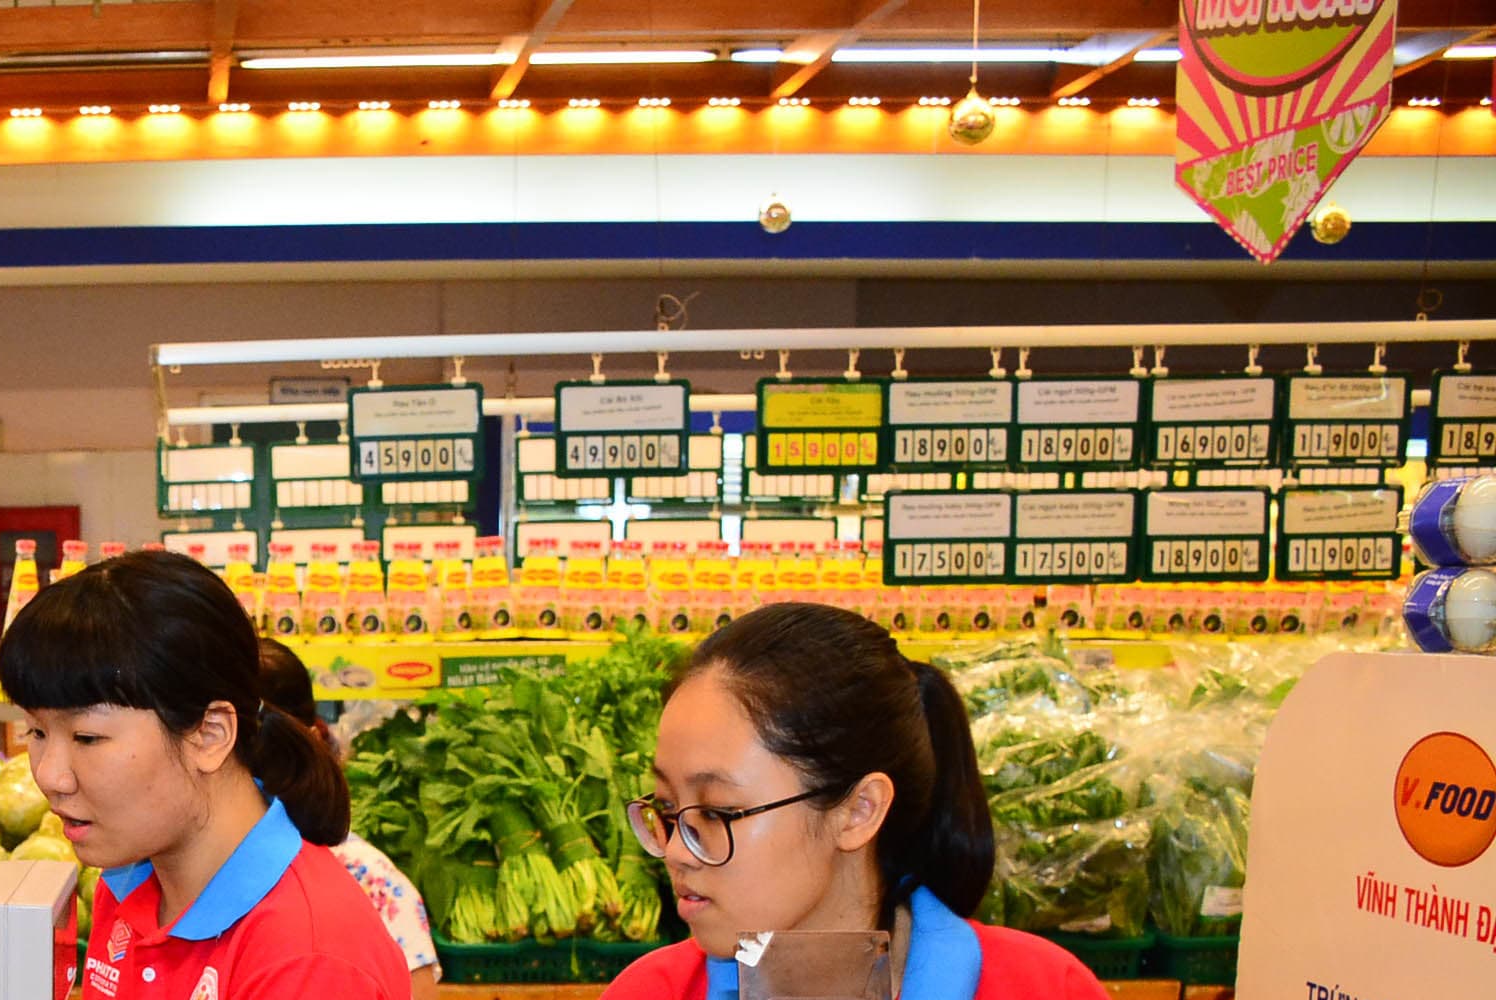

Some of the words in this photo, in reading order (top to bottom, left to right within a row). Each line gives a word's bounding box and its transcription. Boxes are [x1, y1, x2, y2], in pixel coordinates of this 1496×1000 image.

[1226, 164, 1263, 197] BEST
[1268, 143, 1318, 184] PRICE
[1356, 872, 1396, 919] VĨNH
[1404, 884, 1469, 938] THÀNH
